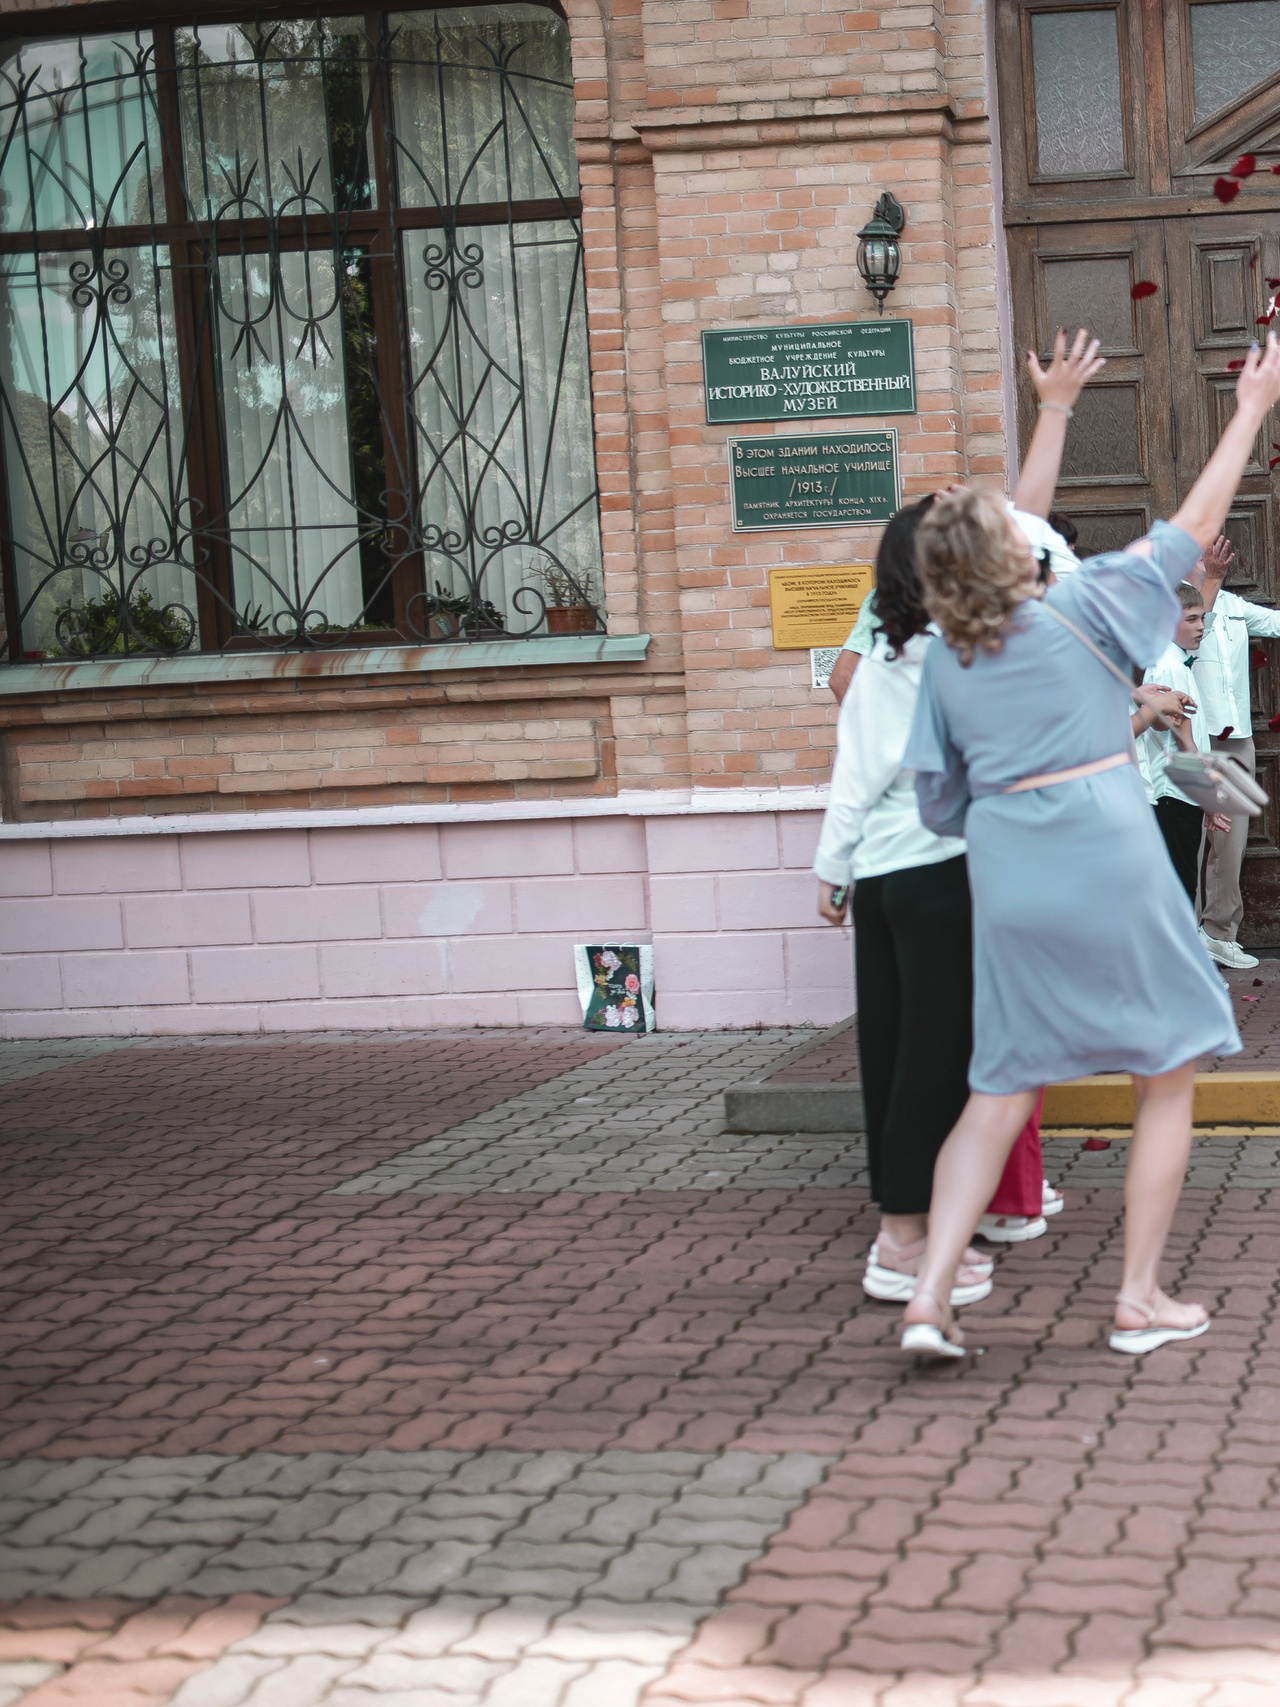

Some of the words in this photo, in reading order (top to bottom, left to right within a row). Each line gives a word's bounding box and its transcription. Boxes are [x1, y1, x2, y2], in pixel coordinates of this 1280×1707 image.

[723, 334, 768, 342] МИНИСТЕРСТВО
[811, 328, 853, 337] РОССИЙСКОЙ
[860, 327, 891, 335] ФЕДЕРАЦИИ
[771, 340, 842, 351] МУНИЦИПАЛЬНОЕ
[728, 355, 775, 365] БЮДЖЕТНОЕ
[785, 352, 837, 361] УЧРЕЖДЕНИЕ
[847, 349, 885, 358] КУЛЬТУРЫ
[760, 361, 857, 381] ВАЛУЙСКИЙ
[708, 374, 911, 400] ИСТОРИКО-ХУДОЖЕСТВЕННЫЙ
[782, 396, 838, 412] МУЗЕЙ
[736, 446, 743, 459] В
[746, 448, 775, 459] ЭТОМ
[778, 446, 818, 458] ЗДАНИИ
[822, 442, 892, 455] НАХОДИЛОСЬ
[735, 465, 775, 478] ВЫСШЕЕ
[781, 463, 840, 476] НАЧАЛЬНОЕ
[844, 460, 892, 472] УЧИЛИЩЕ
[743, 502, 780, 510] ПАМЯТНИК
[784, 499, 834, 508] АРХИТЕКТУРЫ
[838, 497, 864, 506] КОНЦА
[762, 511, 807, 521] ОХРАНЯЕТСЯ
[812, 508, 872, 518] ГОСУДАРСТВОМ
